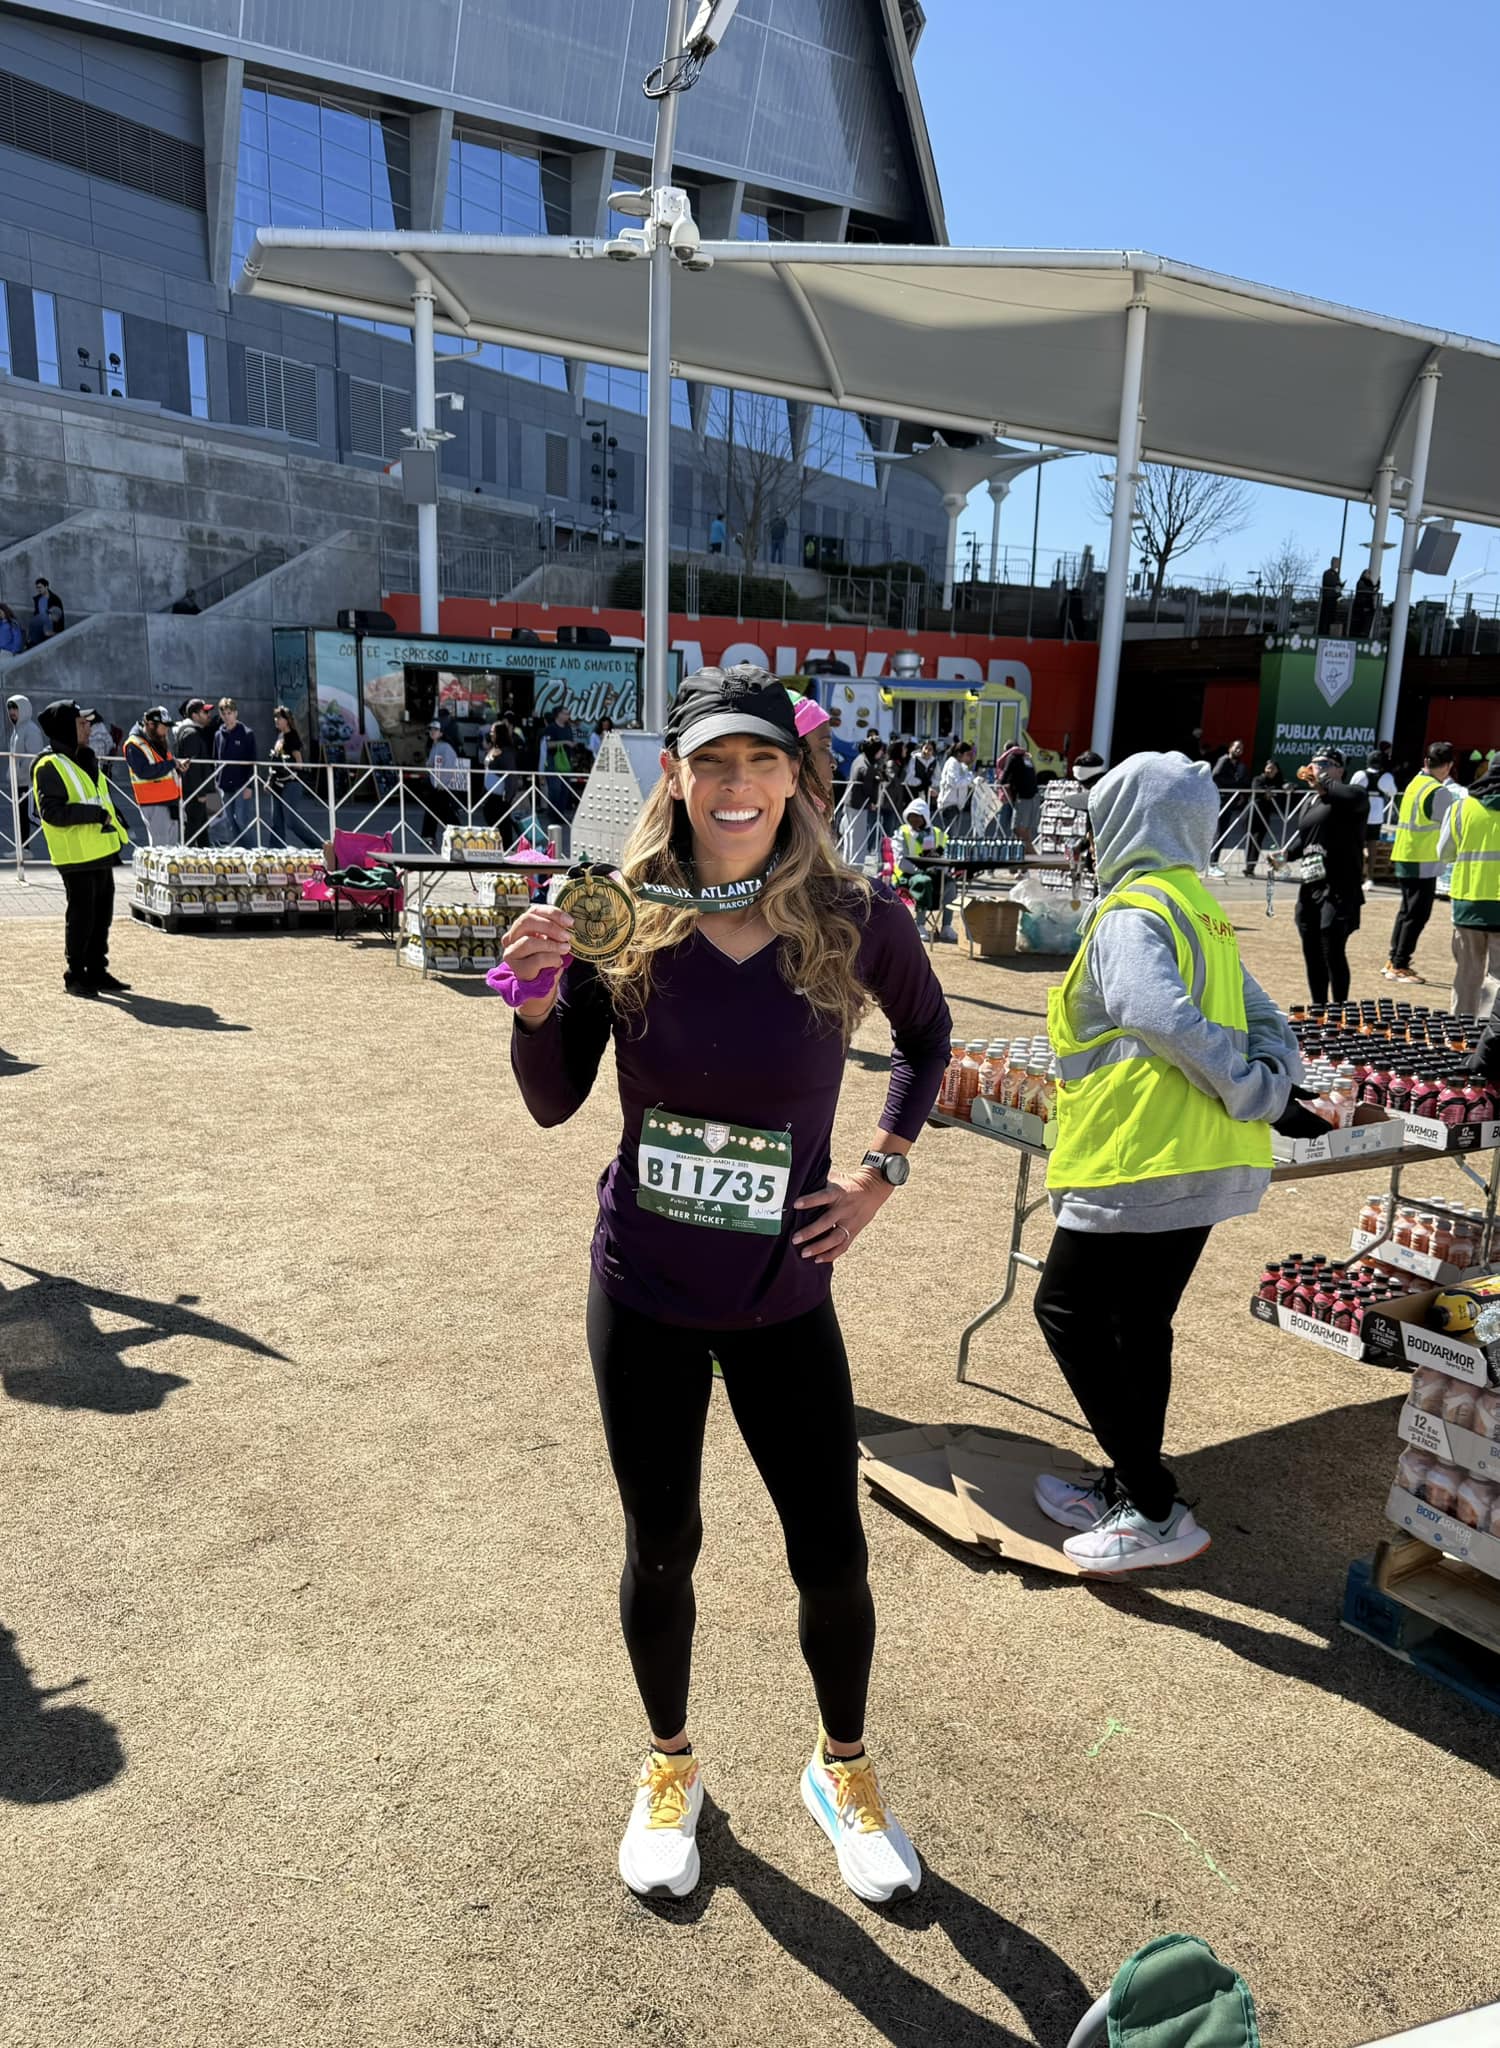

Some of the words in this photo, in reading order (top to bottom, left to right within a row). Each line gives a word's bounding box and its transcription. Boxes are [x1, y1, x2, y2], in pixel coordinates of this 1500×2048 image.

[339, 643, 380, 658] COEE
[394, 647, 449, 662] ESPRESSO
[462, 651, 493, 665] LATTE
[506, 654, 557, 669] SMOOTHIE
[560, 657, 581, 671] AND
[584, 658, 622, 672] SHAVED
[625, 661, 638, 673] IC
[1276, 724, 1320, 740] PUBLIX
[1324, 726, 1376, 742] ATLANTA
[1274, 743, 1324, 756] MARATHO
[643, 882, 693, 898] PUBLIX
[701, 878, 764, 899] ATLANTA
[719, 899, 748, 910] MARCH
[1405, 1123, 1439, 1140] YARMOR
[647, 1157, 776, 1204] B11735
[668, 1208, 690, 1220] BEER
[693, 1212, 727, 1226] TICKET
[1290, 1315, 1349, 1347] BODYARMOR
[1374, 1318, 1387, 1332] 12
[1407, 1334, 1475, 1370] BODYARMOR
[1414, 1414, 1427, 1430] 12
